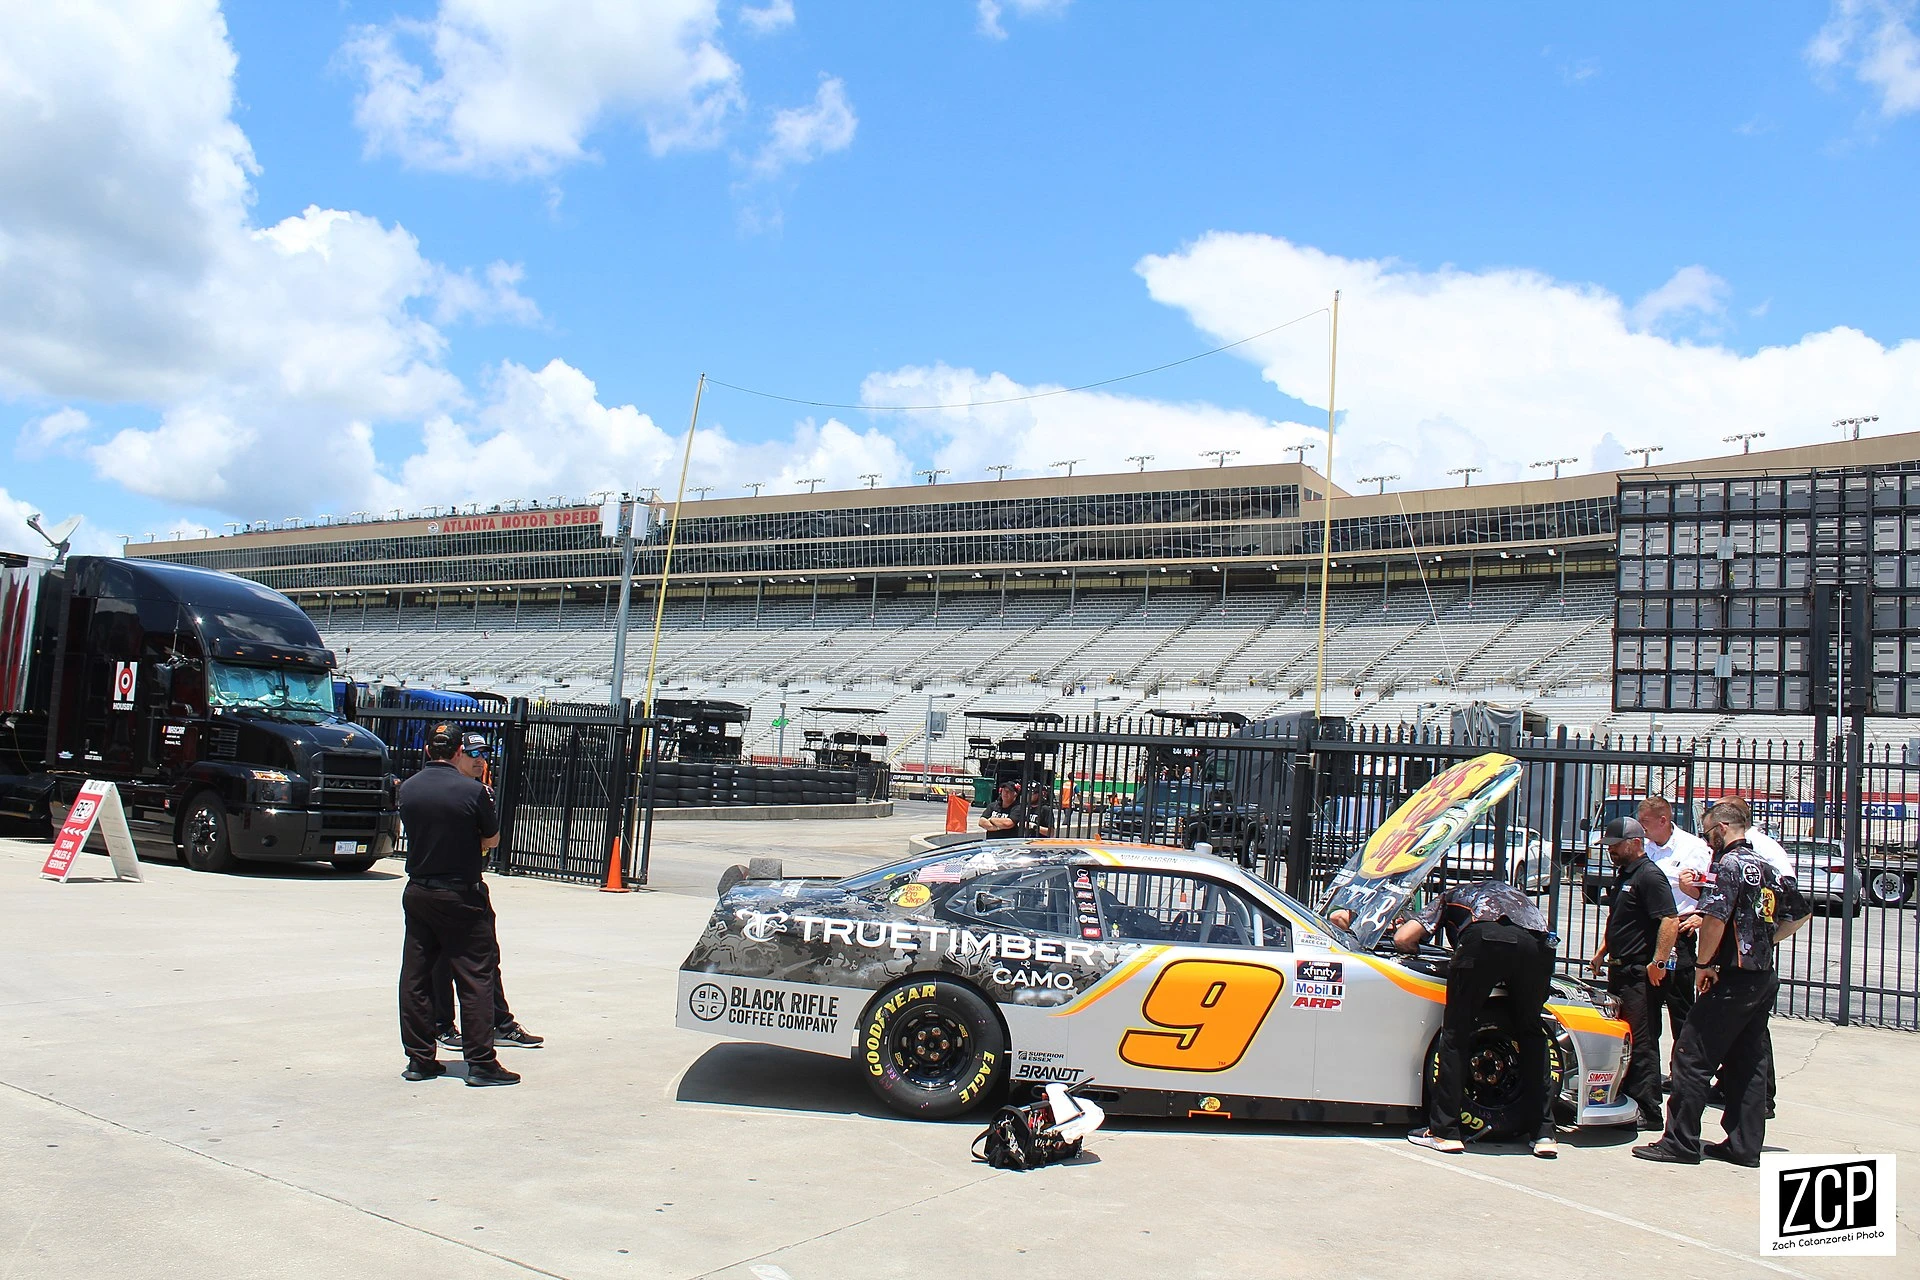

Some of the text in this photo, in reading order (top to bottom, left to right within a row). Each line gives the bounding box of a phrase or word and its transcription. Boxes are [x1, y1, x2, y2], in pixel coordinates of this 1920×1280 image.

[443, 518, 496, 533] ATLANTA
[502, 514, 547, 528] MOTOR
[324, 779, 380, 789] MACK
[60, 839, 75, 849] TEAM
[52, 849, 67, 859] SALES
[47, 859, 68, 870] SERVICE
[903, 896, 925, 905] Shops
[792, 915, 1096, 966] TRUETIMBER
[993, 968, 1074, 990] CAMO
[1303, 966, 1337, 979] xfinity
[1296, 983, 1329, 995] Mobil
[731, 986, 839, 1017] BLACK RIFLE
[1293, 996, 1341, 1009] ARP
[729, 1008, 838, 1034] COFFEE COMPANY
[1119, 959, 1285, 1073] 9
[1028, 1051, 1065, 1059] SUPERIOR
[959, 1051, 995, 1104] EAGLE
[1015, 1064, 1084, 1082] BRANDT
